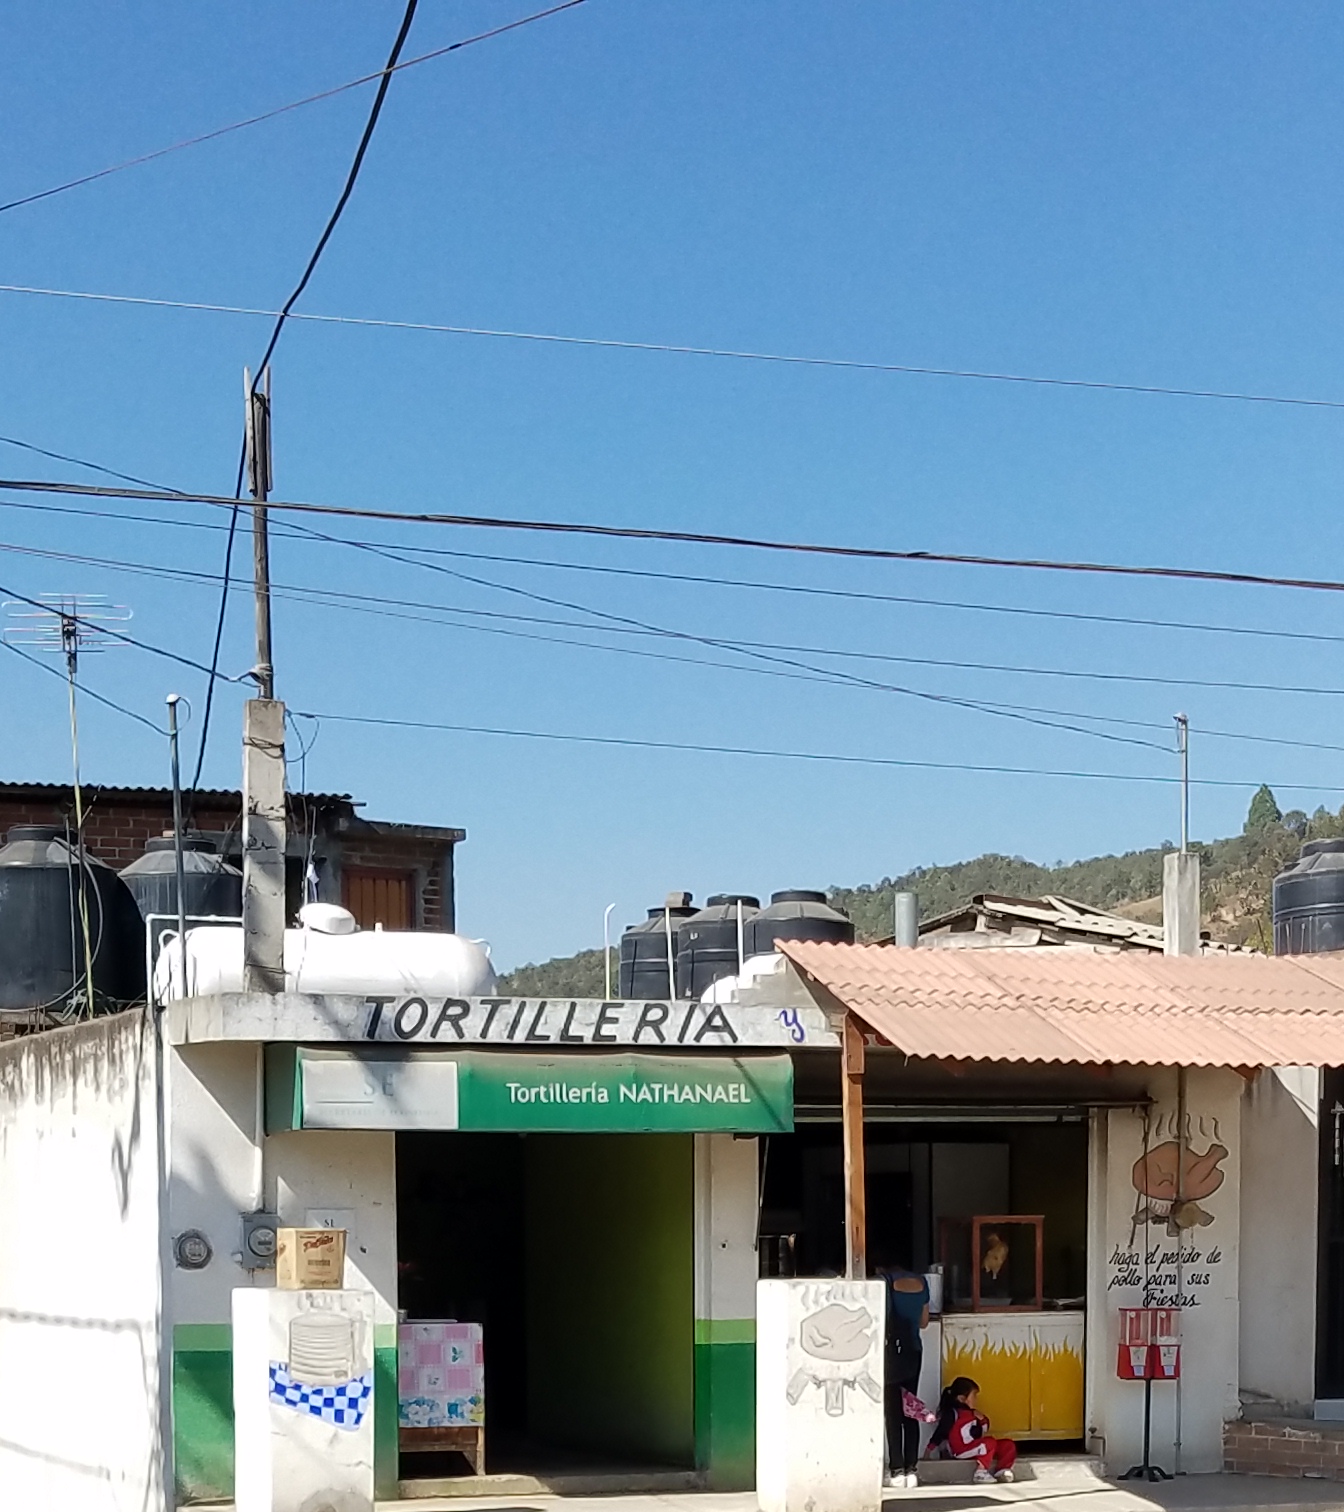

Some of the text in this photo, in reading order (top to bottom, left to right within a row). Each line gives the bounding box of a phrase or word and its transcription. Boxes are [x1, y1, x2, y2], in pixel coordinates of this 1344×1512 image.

[365, 996, 738, 1043] TORTILLERIA
[506, 1081, 751, 1103] Tortillería NATHANAEL
[1109, 1243, 1140, 1272] haga
[1206, 1246, 1222, 1264] de
[1108, 1268, 1143, 1291] pollo
[1187, 1273, 1210, 1286] sus
